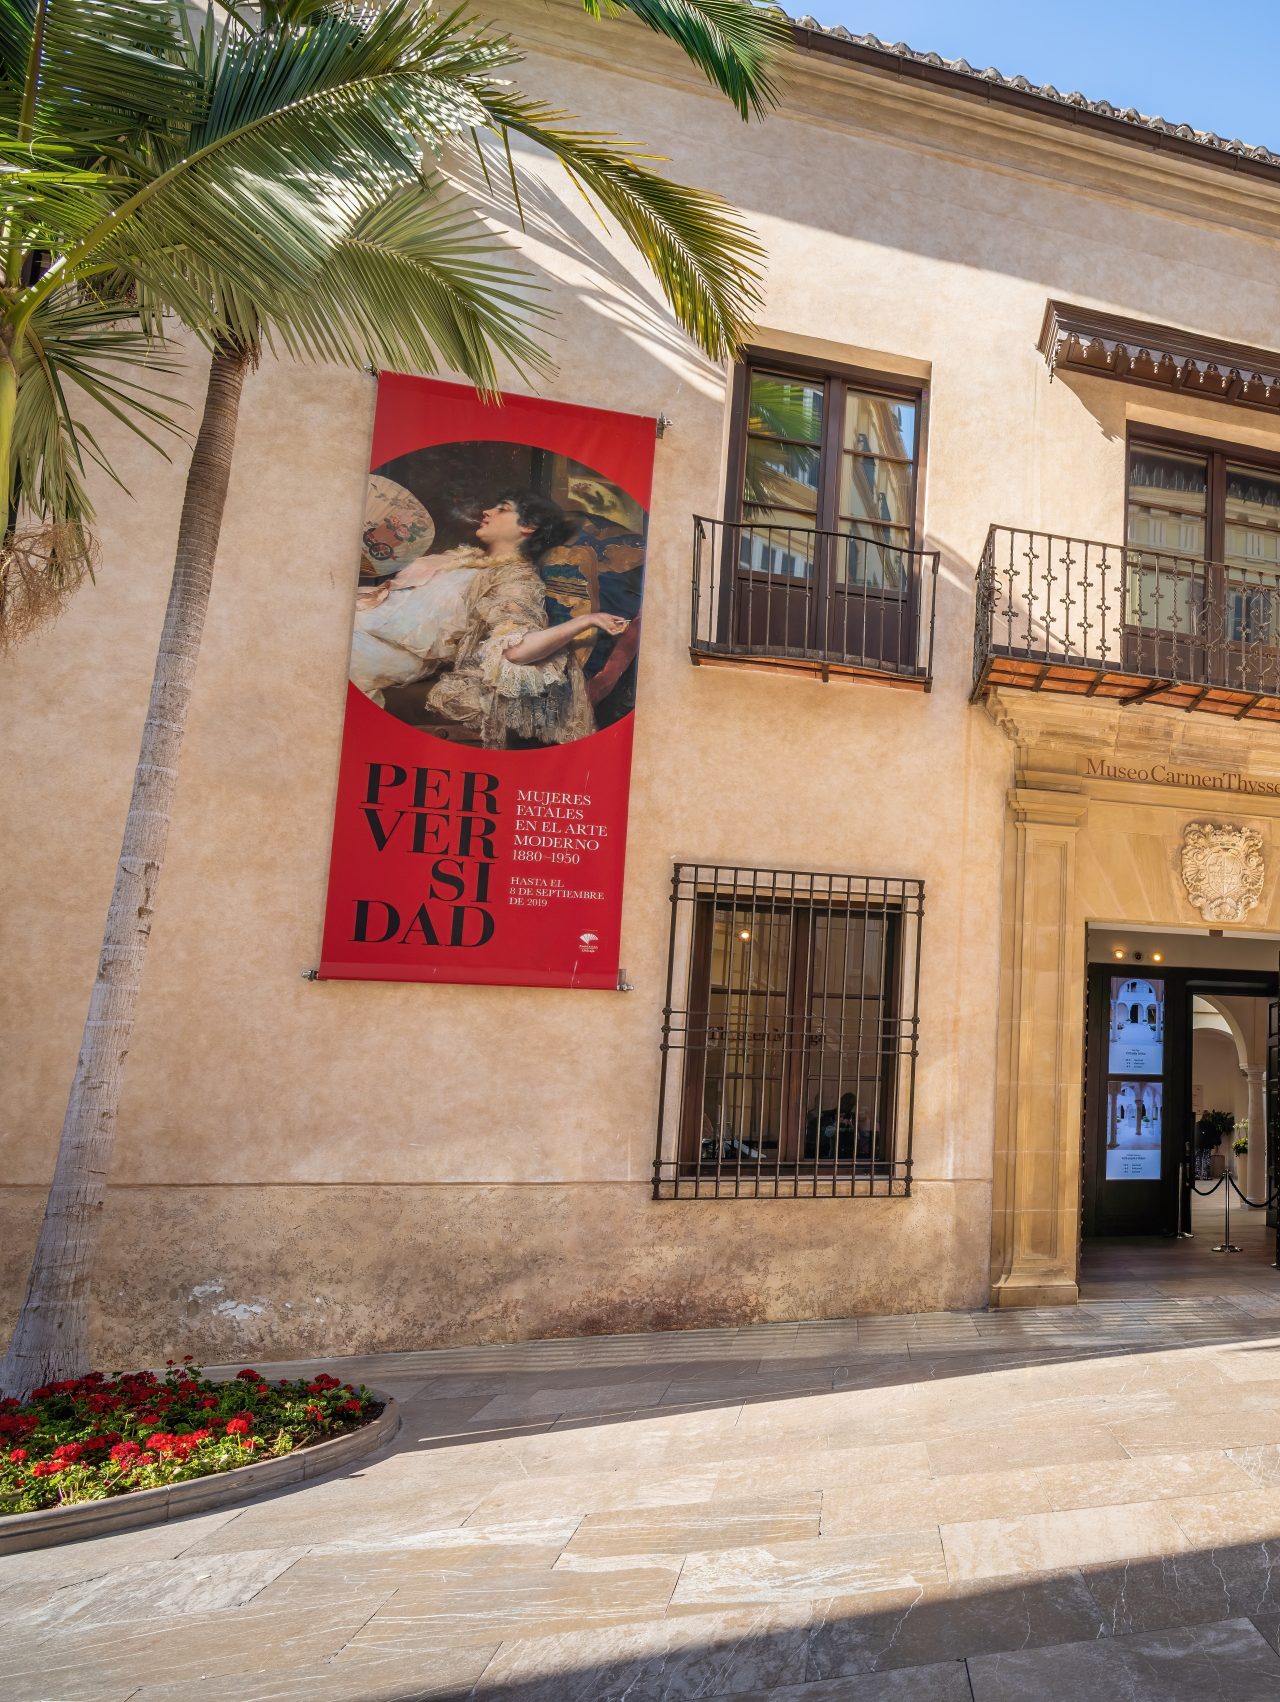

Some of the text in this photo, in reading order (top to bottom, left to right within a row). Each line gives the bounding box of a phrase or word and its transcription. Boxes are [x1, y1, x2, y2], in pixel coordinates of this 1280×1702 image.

[1086, 758, 1149, 780] Museo
[360, 762, 502, 815] PER
[517, 790, 592, 806] MUJERES
[516, 804, 584, 820] FATALES
[359, 808, 499, 859] VER
[515, 819, 608, 837] EN EL ARTE
[513, 834, 600, 851] MODERNO
[429, 858, 495, 903] SI
[510, 876, 565, 888] HASTA EL
[509, 887, 605, 900] 8 DE SEPTIEMBRE
[509, 897, 548, 907] DE 2019
[348, 900, 495, 947] DAD
